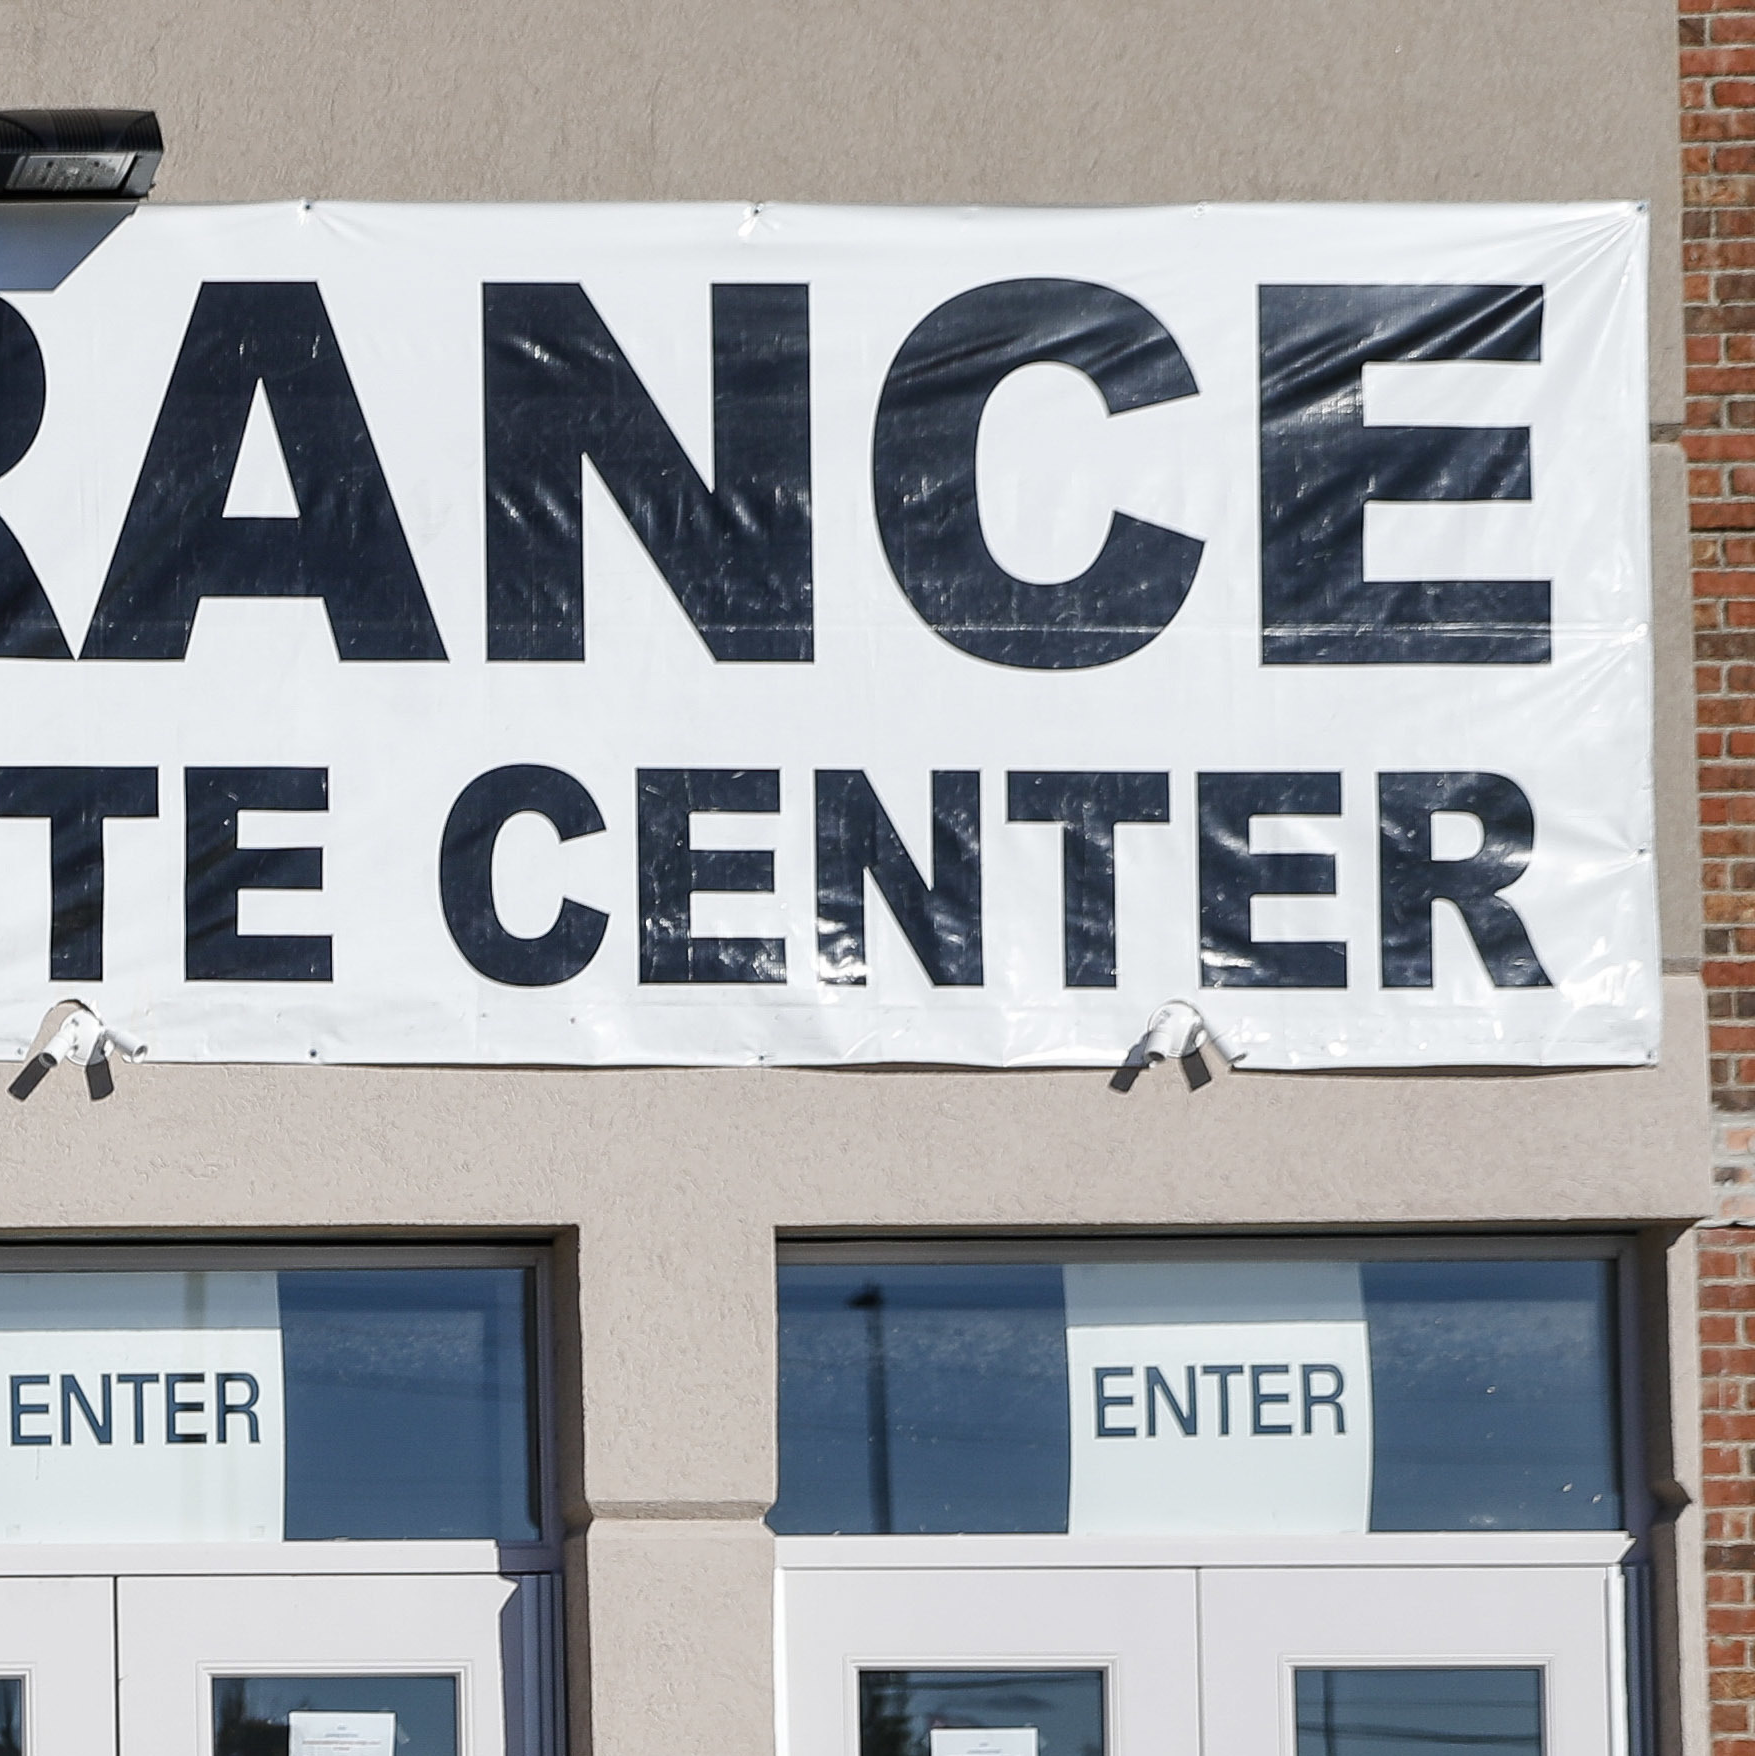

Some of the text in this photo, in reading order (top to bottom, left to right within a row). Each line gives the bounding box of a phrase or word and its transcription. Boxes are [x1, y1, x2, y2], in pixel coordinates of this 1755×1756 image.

[439, 763, 1555, 989] CENTER
[8, 1371, 261, 1447] ENTER
[1092, 1363, 1347, 1439] ENTER
